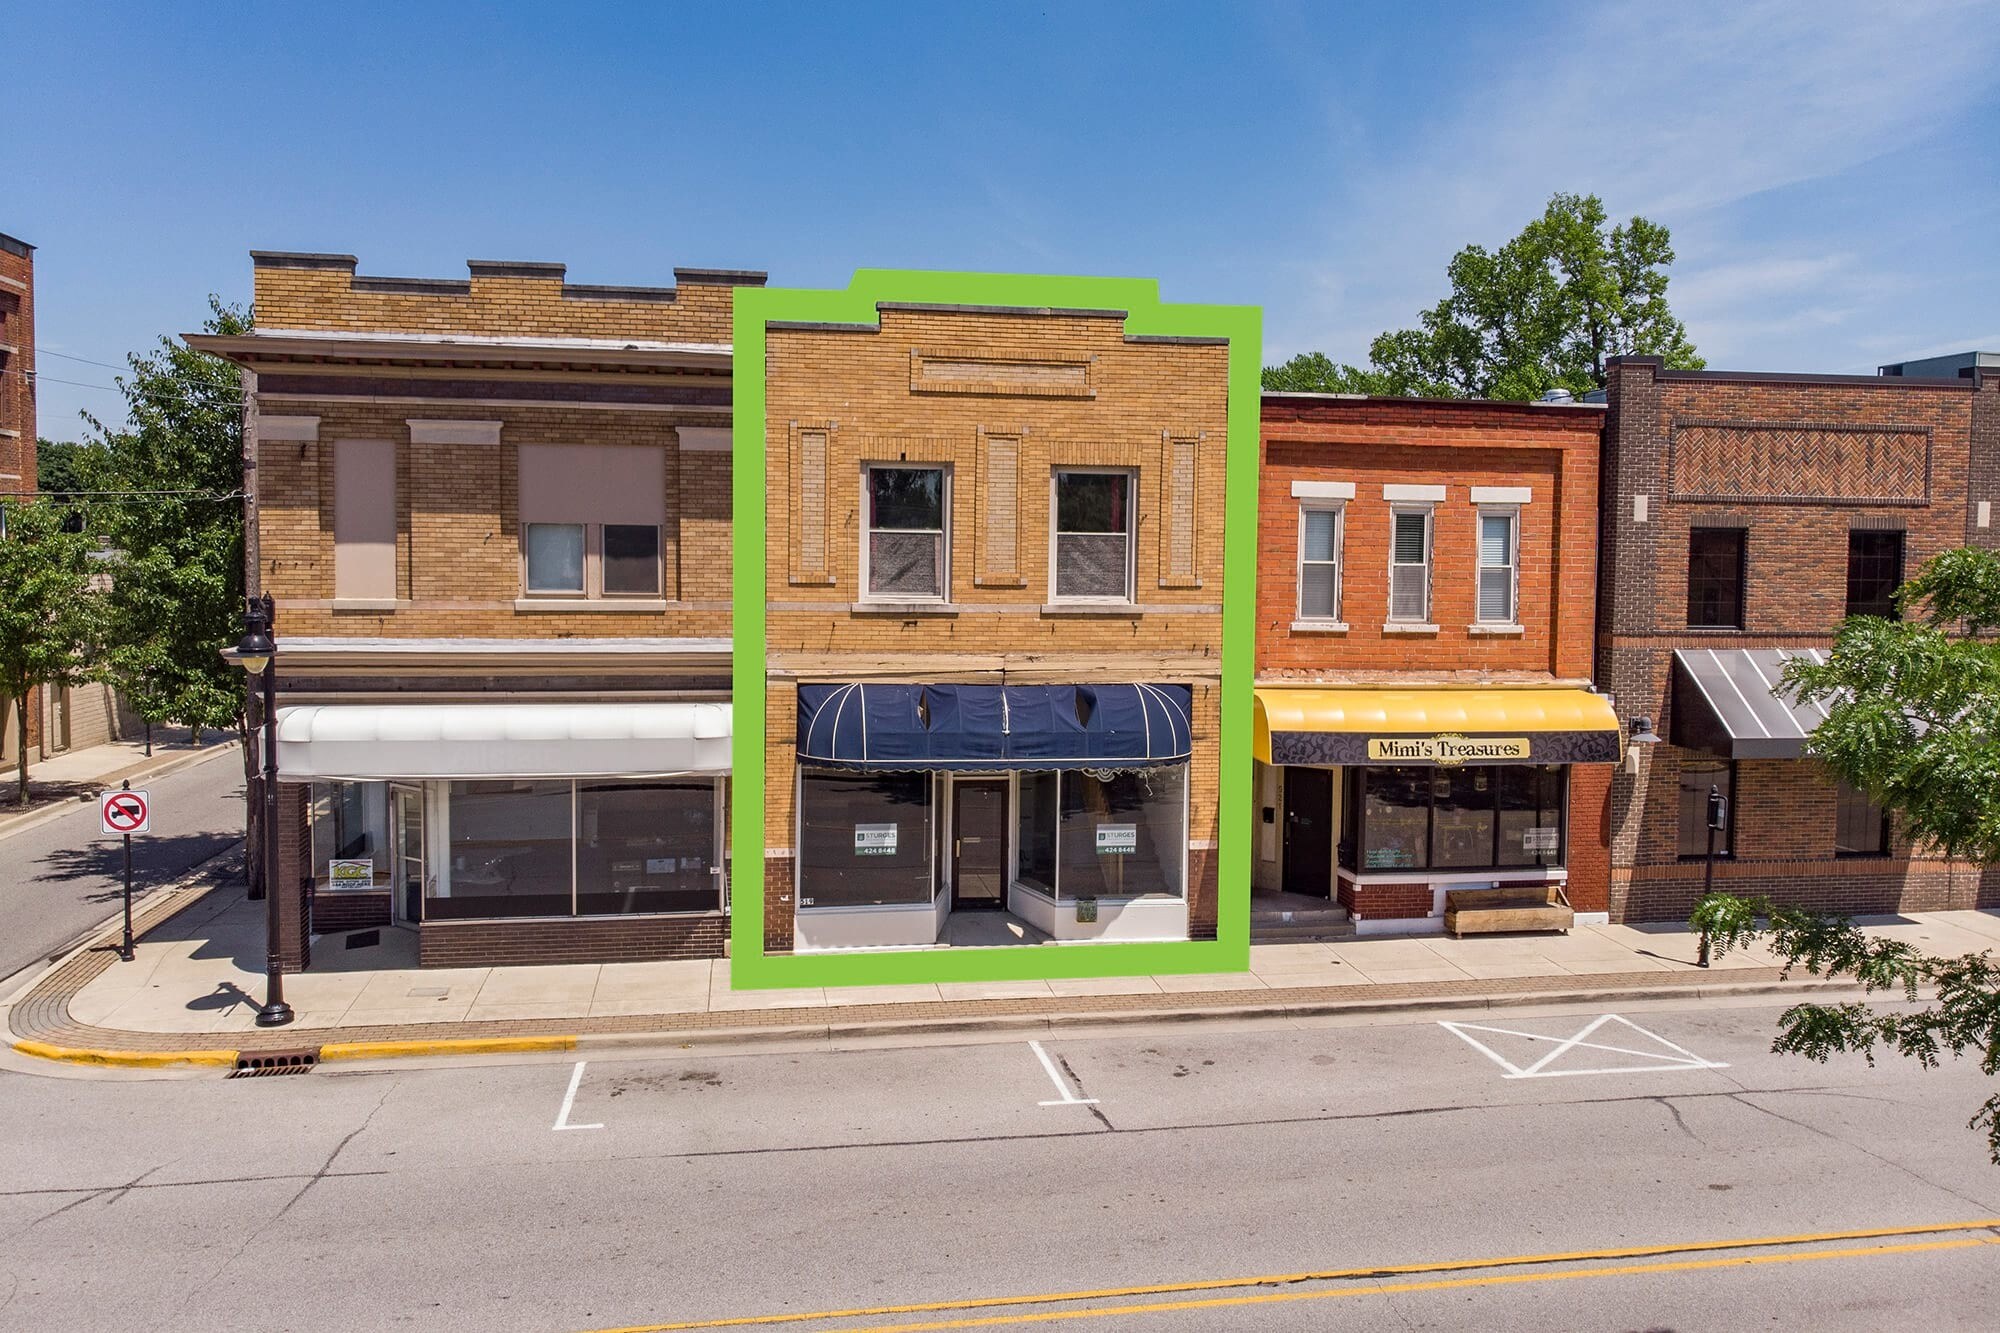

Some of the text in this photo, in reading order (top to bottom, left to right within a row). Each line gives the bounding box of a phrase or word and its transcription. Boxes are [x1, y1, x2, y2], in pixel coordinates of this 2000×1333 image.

[1380, 741, 1520, 757] Mimi's Treasures
[333, 865, 368, 879] KGC
